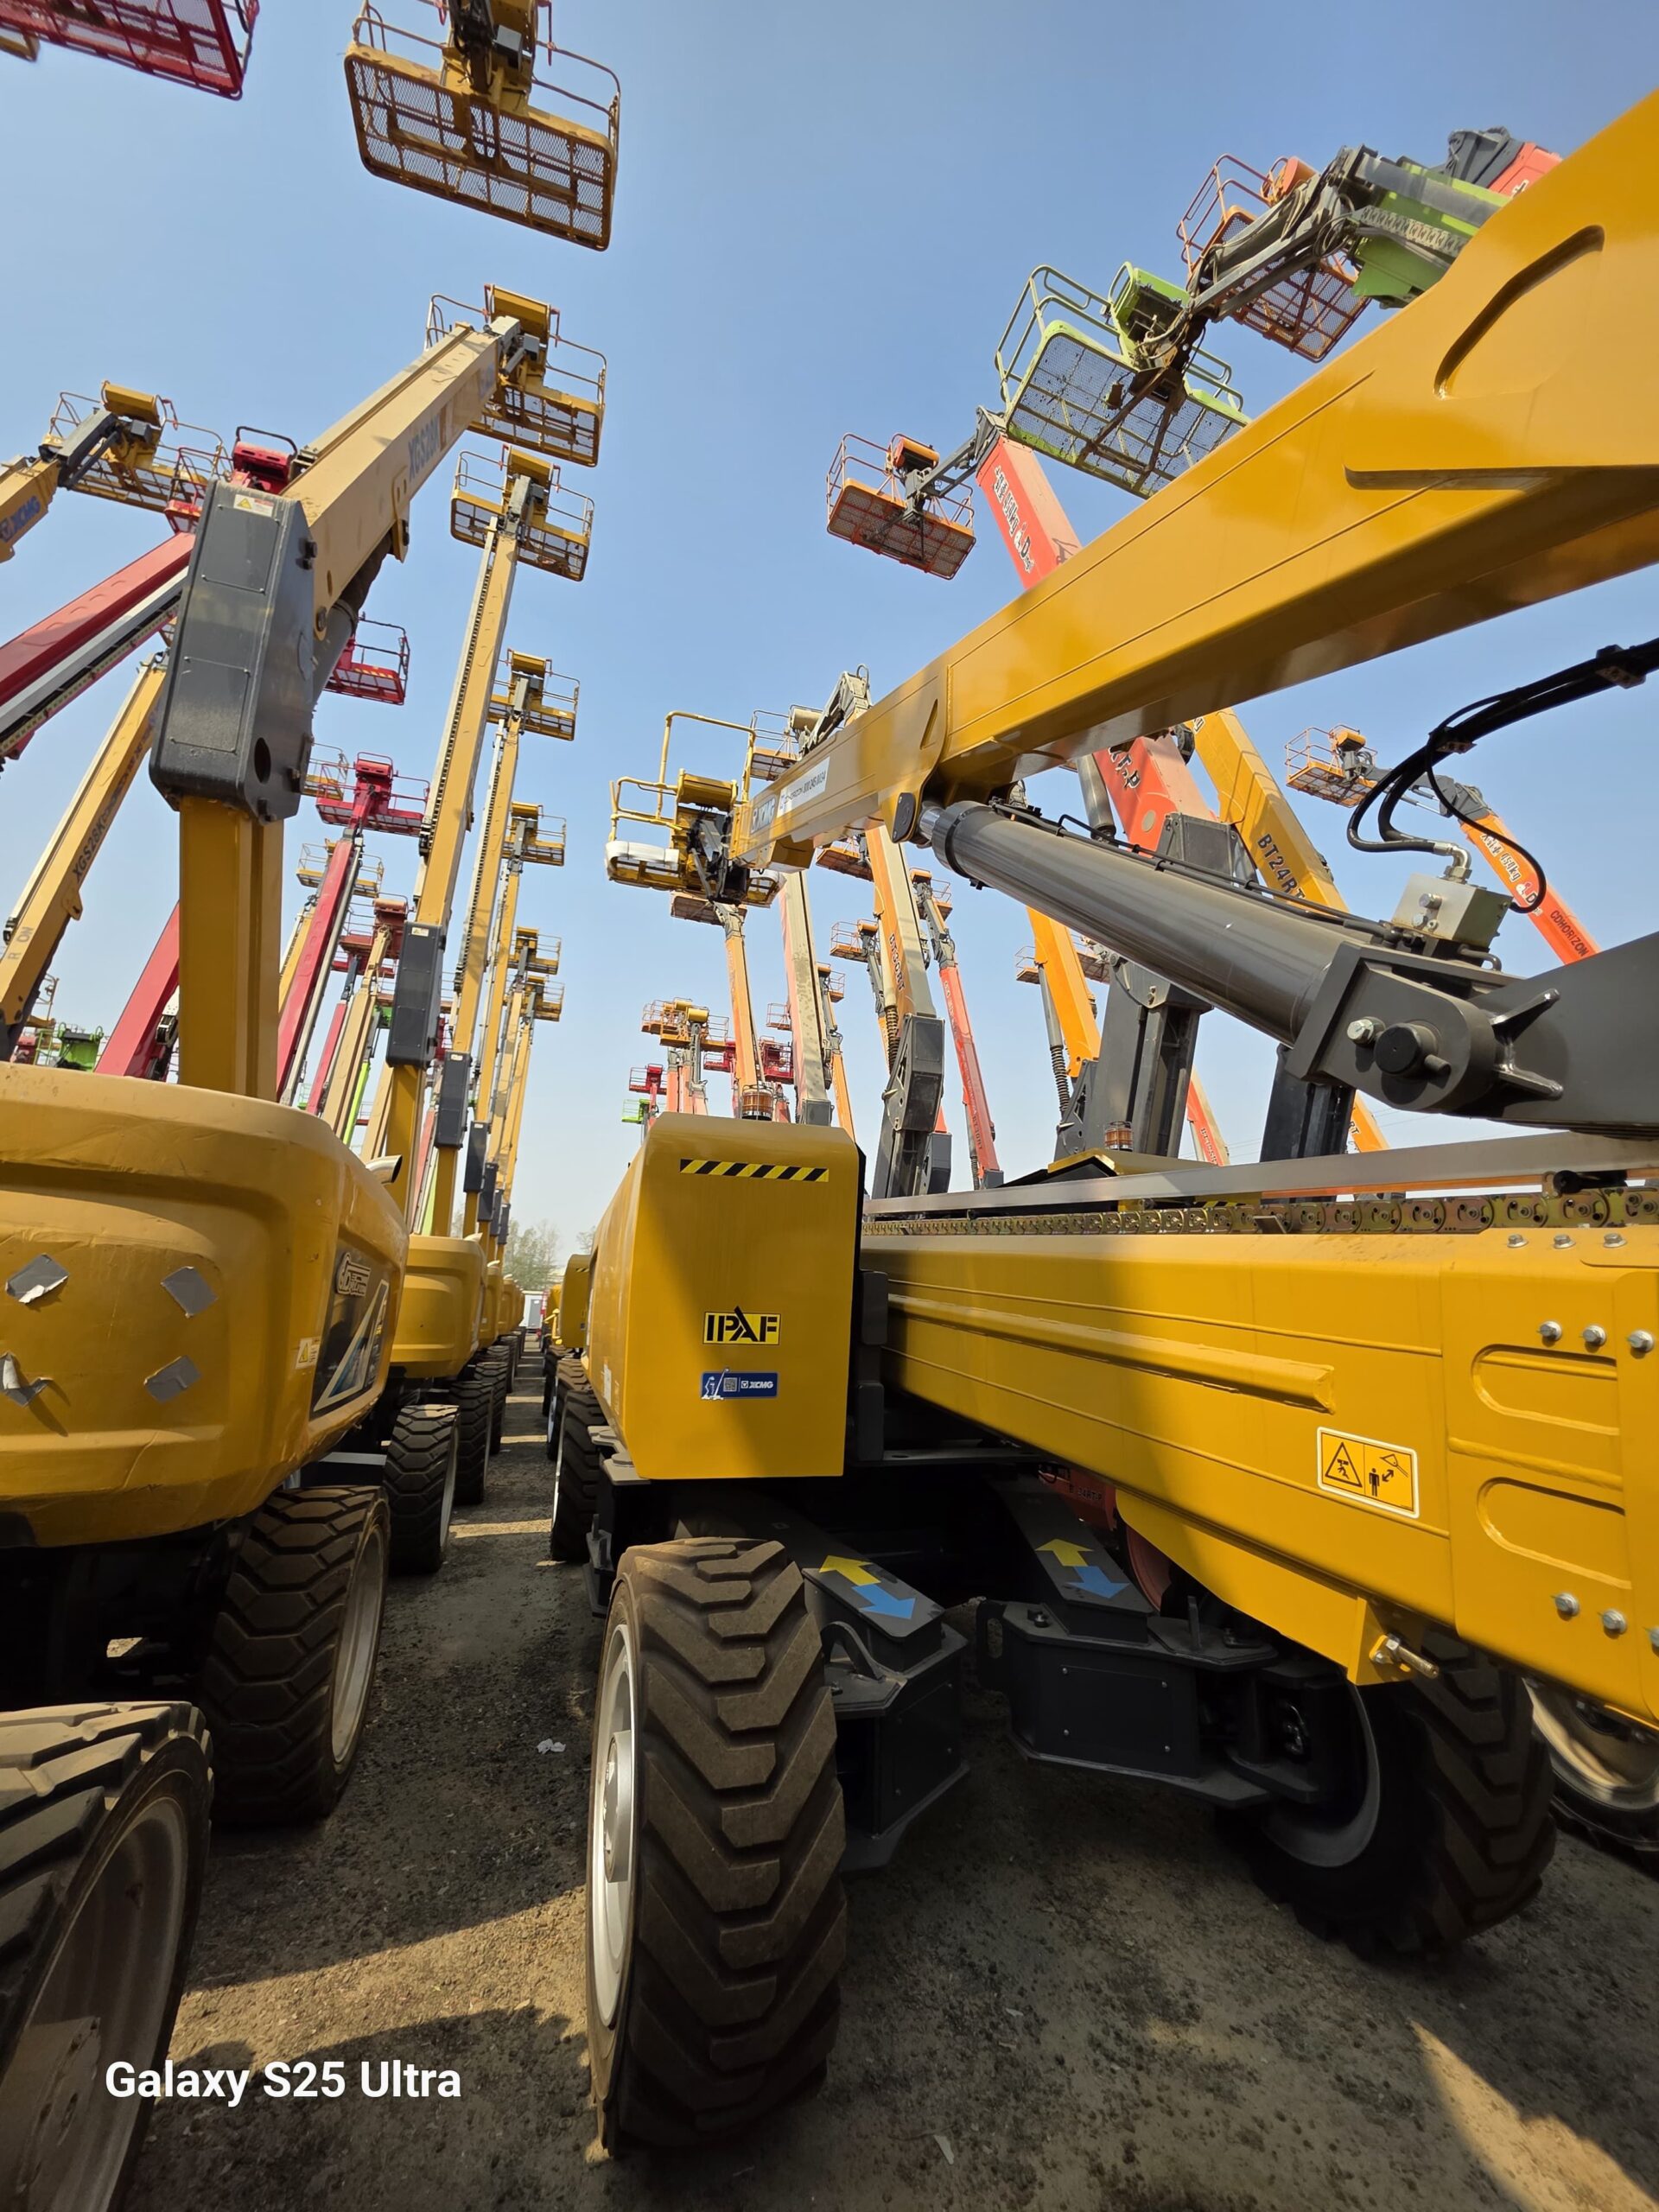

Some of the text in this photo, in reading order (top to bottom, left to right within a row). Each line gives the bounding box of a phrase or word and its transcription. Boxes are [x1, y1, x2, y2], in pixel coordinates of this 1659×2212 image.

[1258, 834, 1306, 898] BT24RT
[1550, 910, 1590, 957] CDHORIZON
[707, 1306, 778, 1342] IPAF
